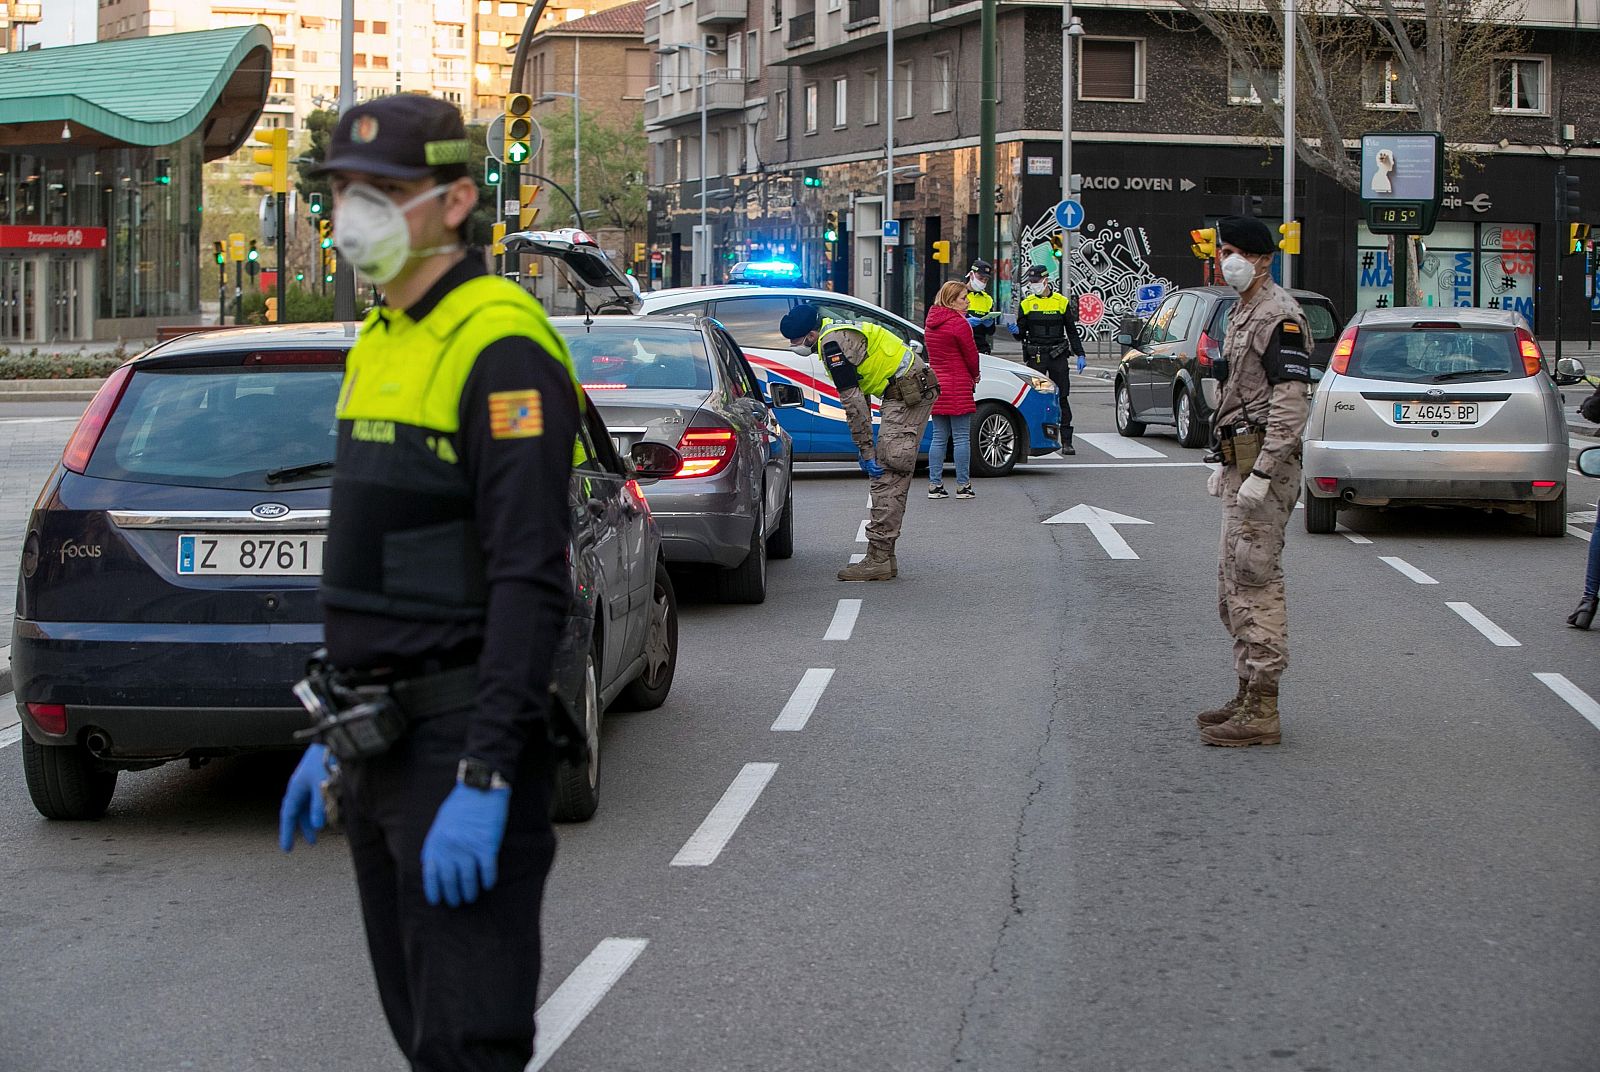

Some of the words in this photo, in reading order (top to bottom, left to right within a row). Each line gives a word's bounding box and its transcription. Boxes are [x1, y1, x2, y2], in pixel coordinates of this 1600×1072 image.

[1124, 178, 1172, 191] JOVEN
[1384, 210, 1395, 221] 18
[1402, 405, 1411, 419] Z
[1418, 405, 1452, 420] 4645
[1457, 406, 1475, 420] BP
[200, 540, 218, 569] Z
[239, 540, 308, 569] 8761
